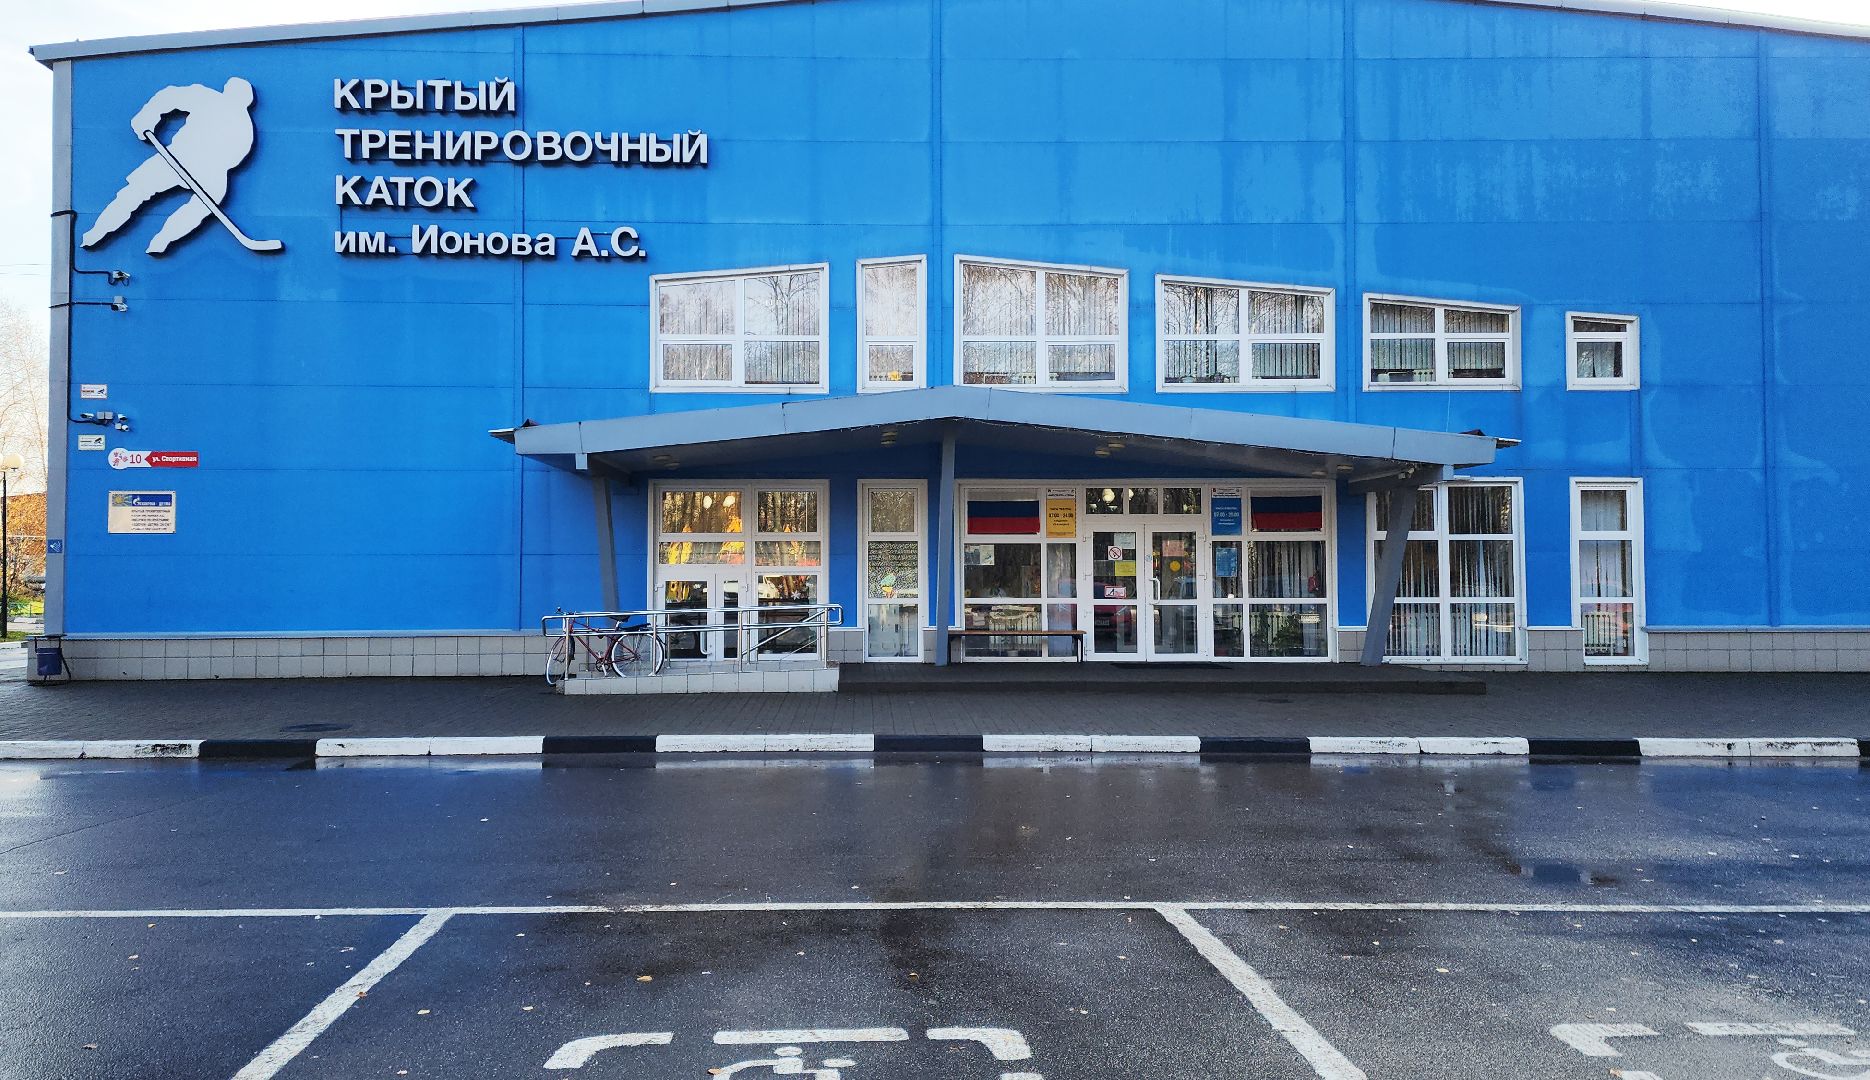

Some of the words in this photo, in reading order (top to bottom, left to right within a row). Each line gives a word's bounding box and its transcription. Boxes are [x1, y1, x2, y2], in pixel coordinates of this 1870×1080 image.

[334, 76, 516, 112] КРЫТЫЙ
[334, 129, 709, 164] ТРЕНИРОВОЧНЫЙ
[334, 175, 476, 208] КАТОК
[334, 231, 397, 254] им.
[411, 224, 556, 256] Ионова
[571, 227, 647, 257] А.С.
[129, 454, 142, 464] 10
